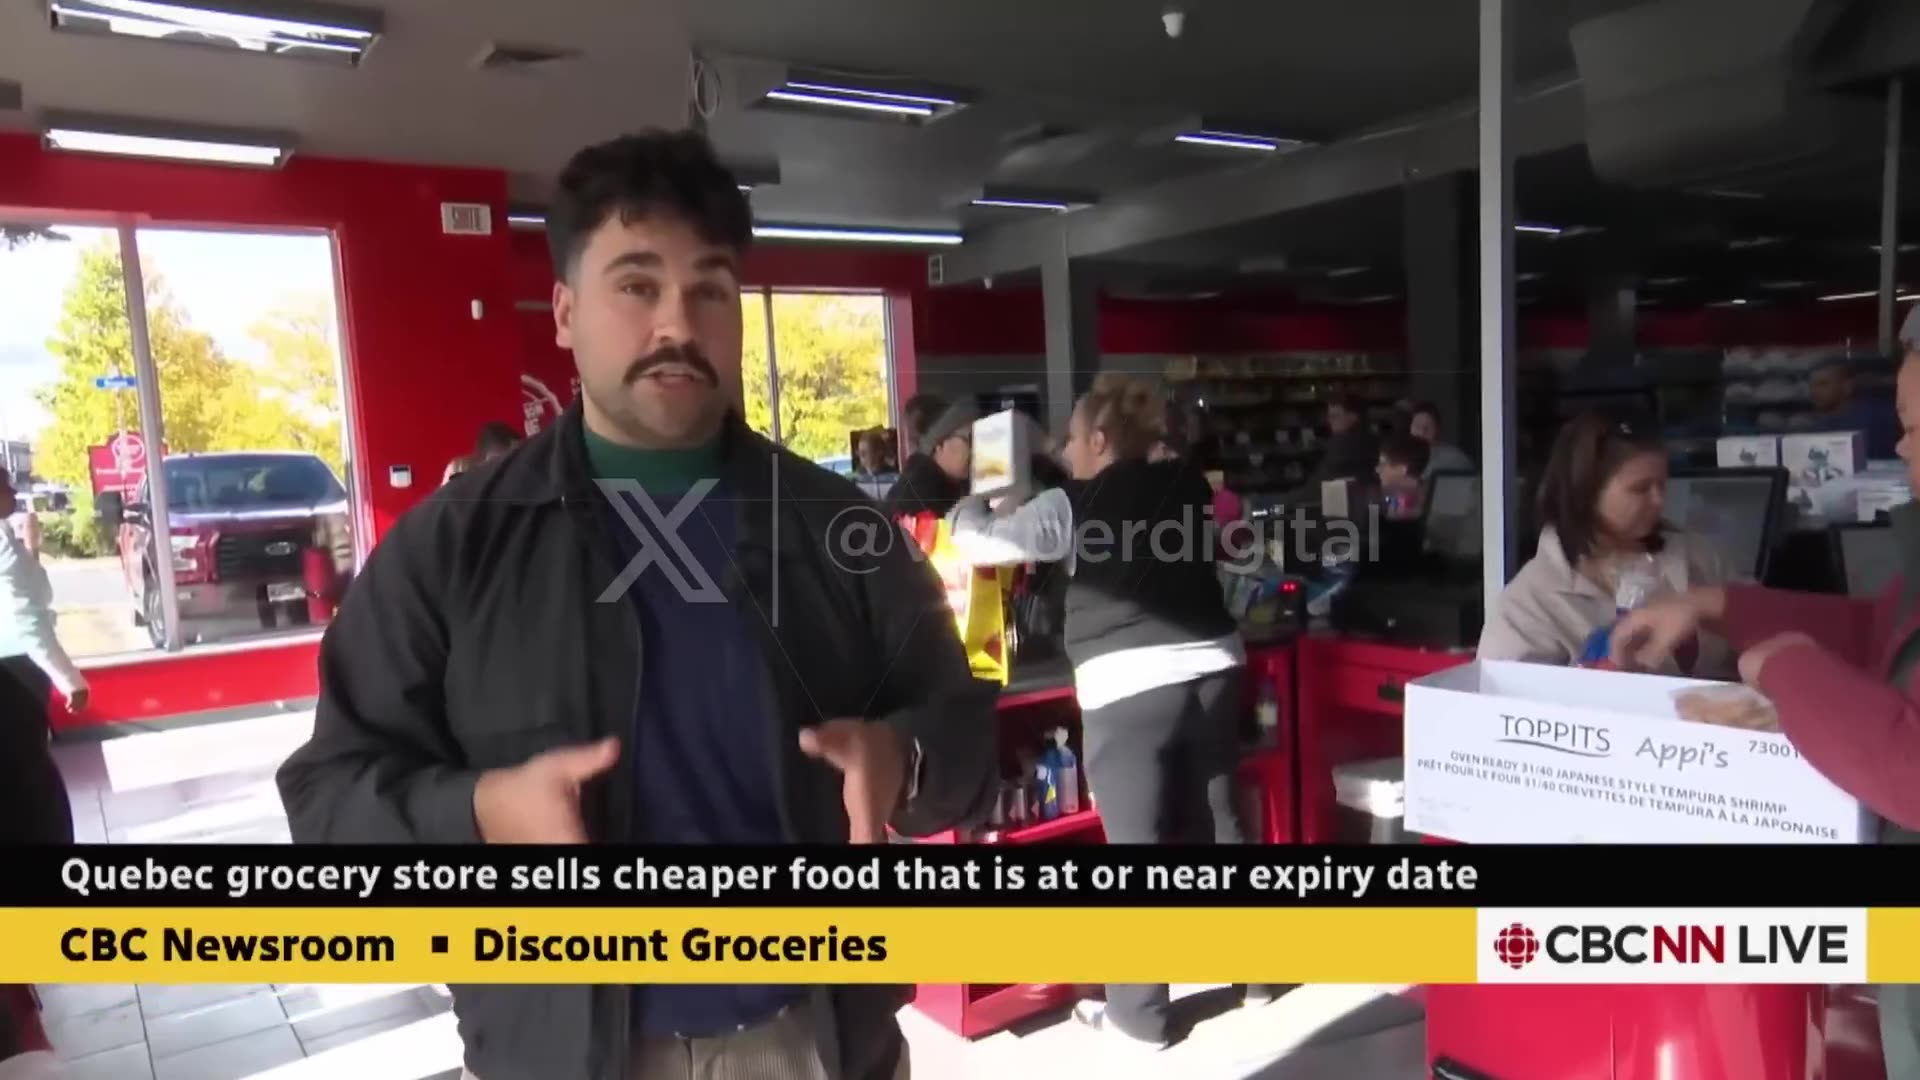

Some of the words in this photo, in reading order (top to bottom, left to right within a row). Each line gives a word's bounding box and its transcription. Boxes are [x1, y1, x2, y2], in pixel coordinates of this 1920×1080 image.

[1499, 714, 1611, 752] TOPPITS
[1417, 755, 1442, 771] PRÊT
[1445, 763, 1474, 777] POUR
[1476, 769, 1488, 780] LE
[1491, 771, 1521, 785] FOUR
[1524, 775, 1555, 791] 31/40
[1559, 780, 1626, 804] CREVETTES
[1629, 795, 1645, 808] DE
[1649, 798, 1714, 820] TEMPURA
[1732, 811, 1750, 825] LA
[1754, 816, 1839, 840] JAPONAISE
[1450, 750, 1480, 765] OVEN
[1482, 756, 1519, 772] READY
[1522, 761, 1553, 777] 31/40
[1556, 767, 1615, 788] JAPANESE
[1619, 775, 1655, 794] STYLE
[1660, 785, 1724, 806] TEMPURA
[1730, 797, 1787, 815] SHRIMP
